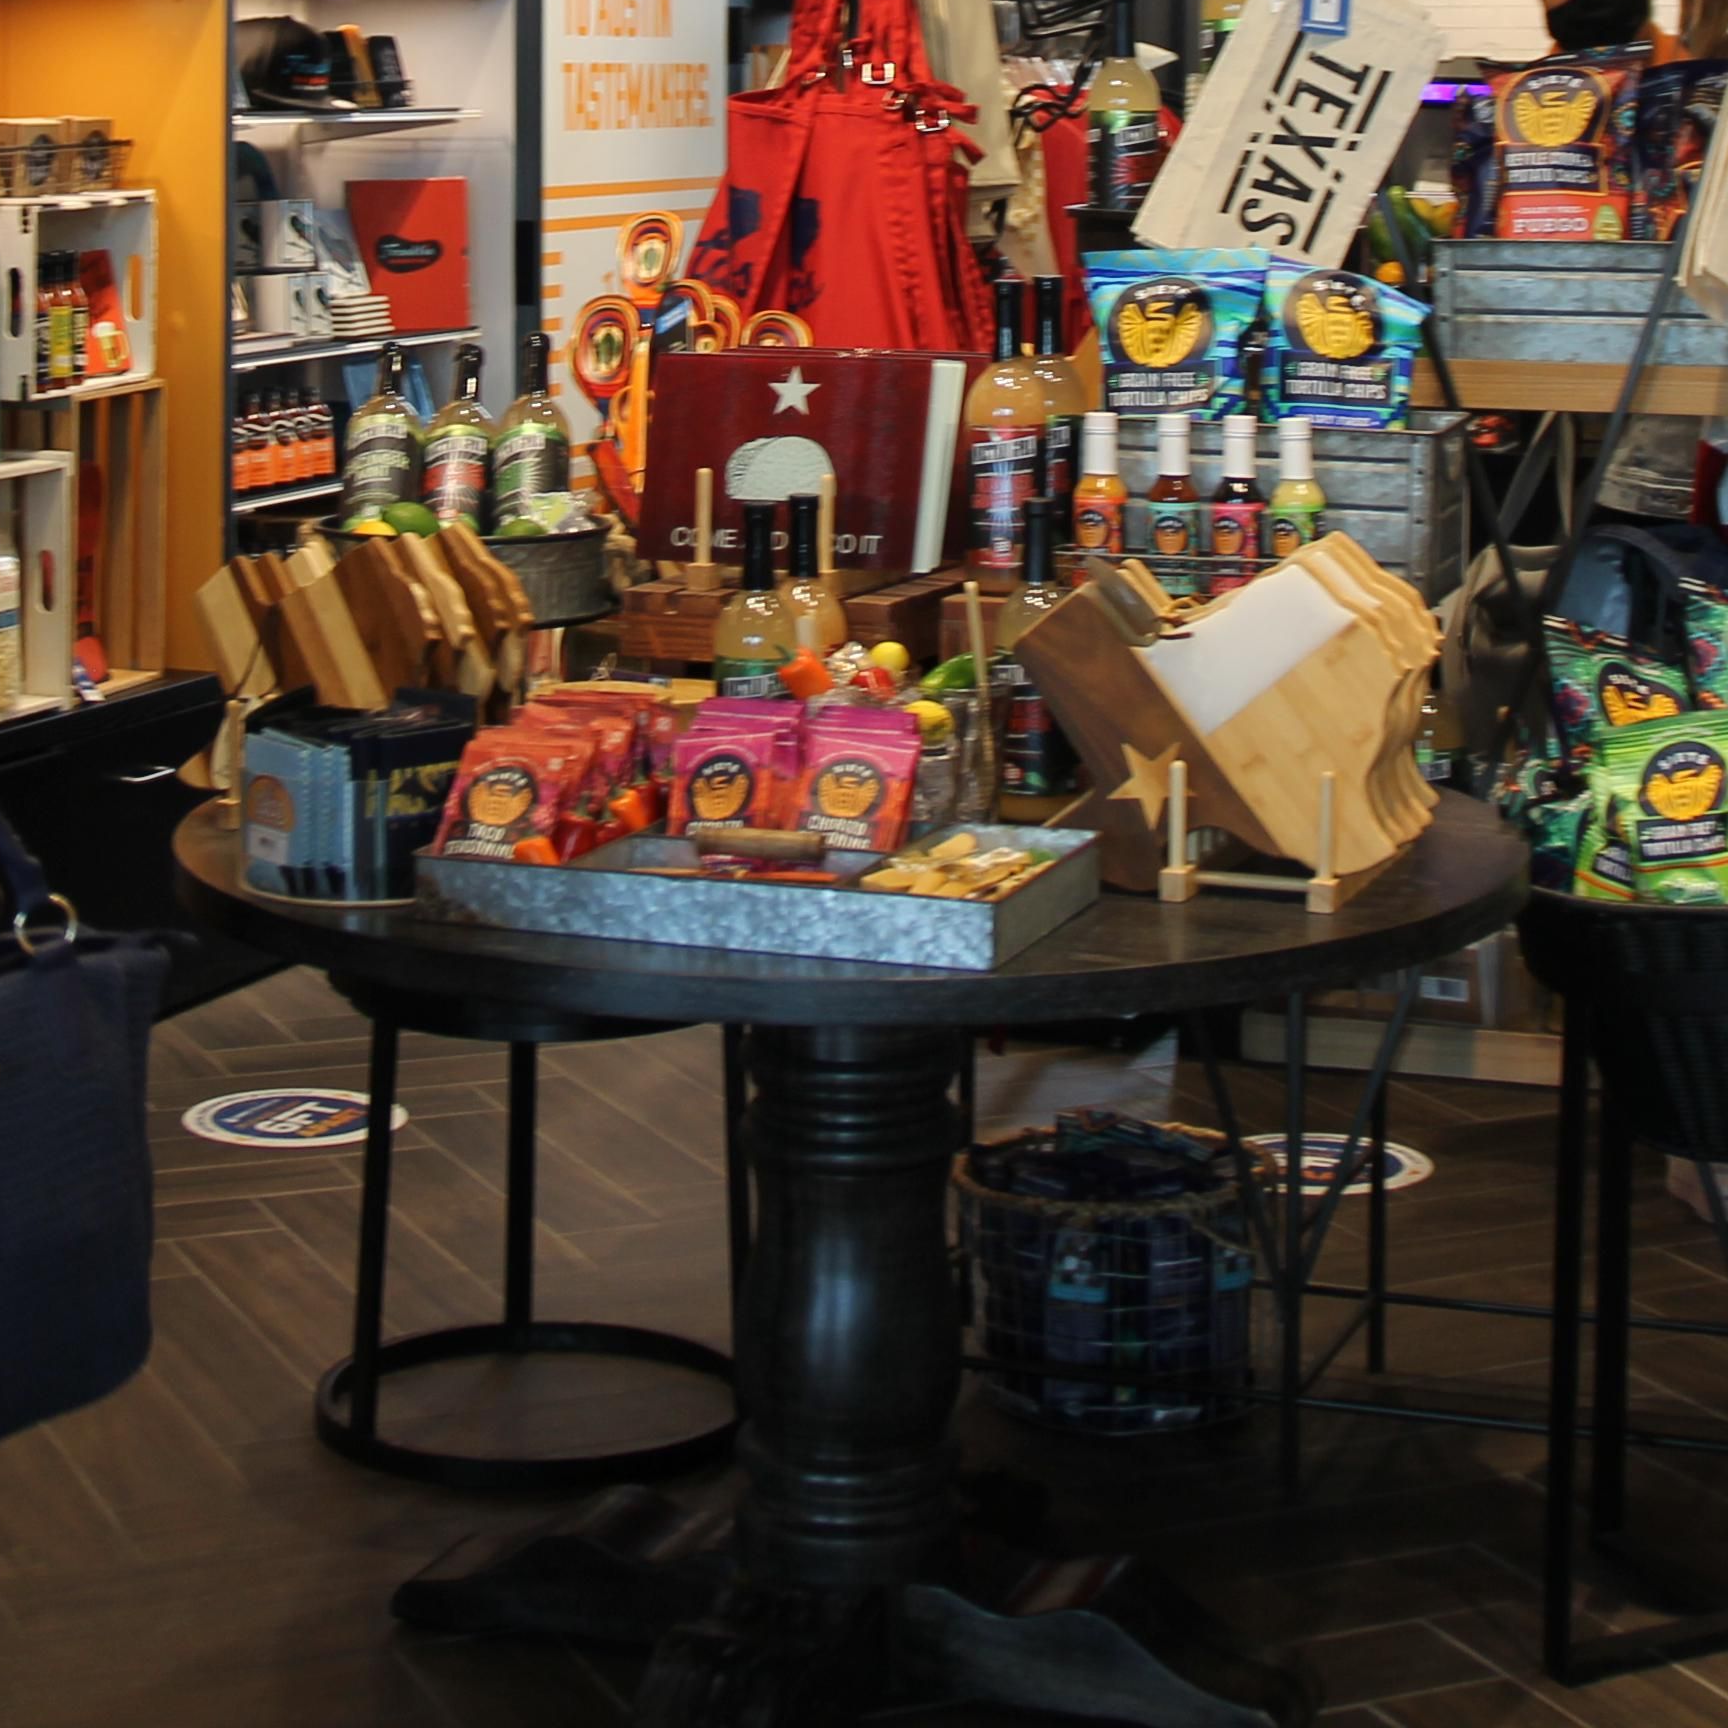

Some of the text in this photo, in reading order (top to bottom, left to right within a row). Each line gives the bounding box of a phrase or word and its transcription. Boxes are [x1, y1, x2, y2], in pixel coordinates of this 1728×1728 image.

[1240, 51, 1373, 248] TEXAS
[1512, 217, 1590, 233] FUEGO
[253, 1101, 341, 1134] 6FT
